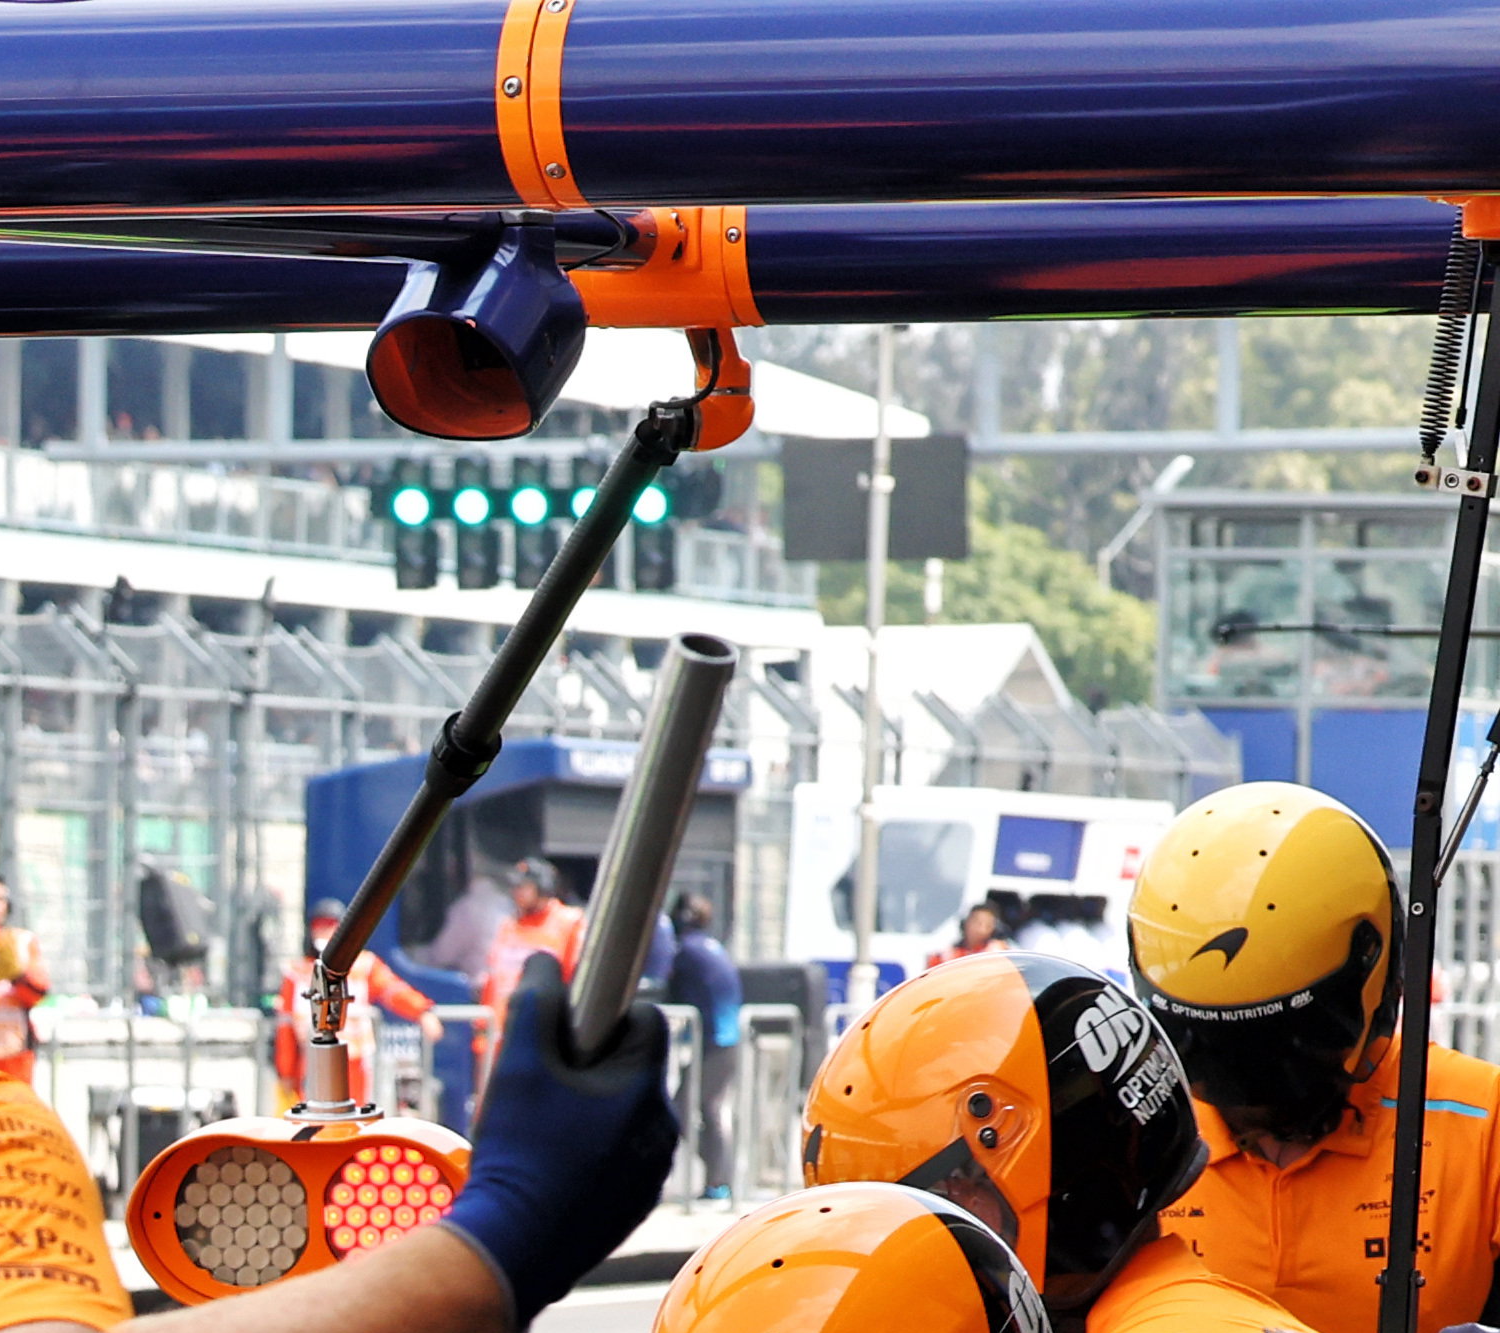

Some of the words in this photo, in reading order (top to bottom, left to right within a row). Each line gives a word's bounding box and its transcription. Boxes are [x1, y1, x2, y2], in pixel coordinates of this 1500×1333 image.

[1074, 984, 1142, 1073] ON
[1172, 1003, 1219, 1021] OPTIMUM
[1221, 1001, 1284, 1022] NUTRITION
